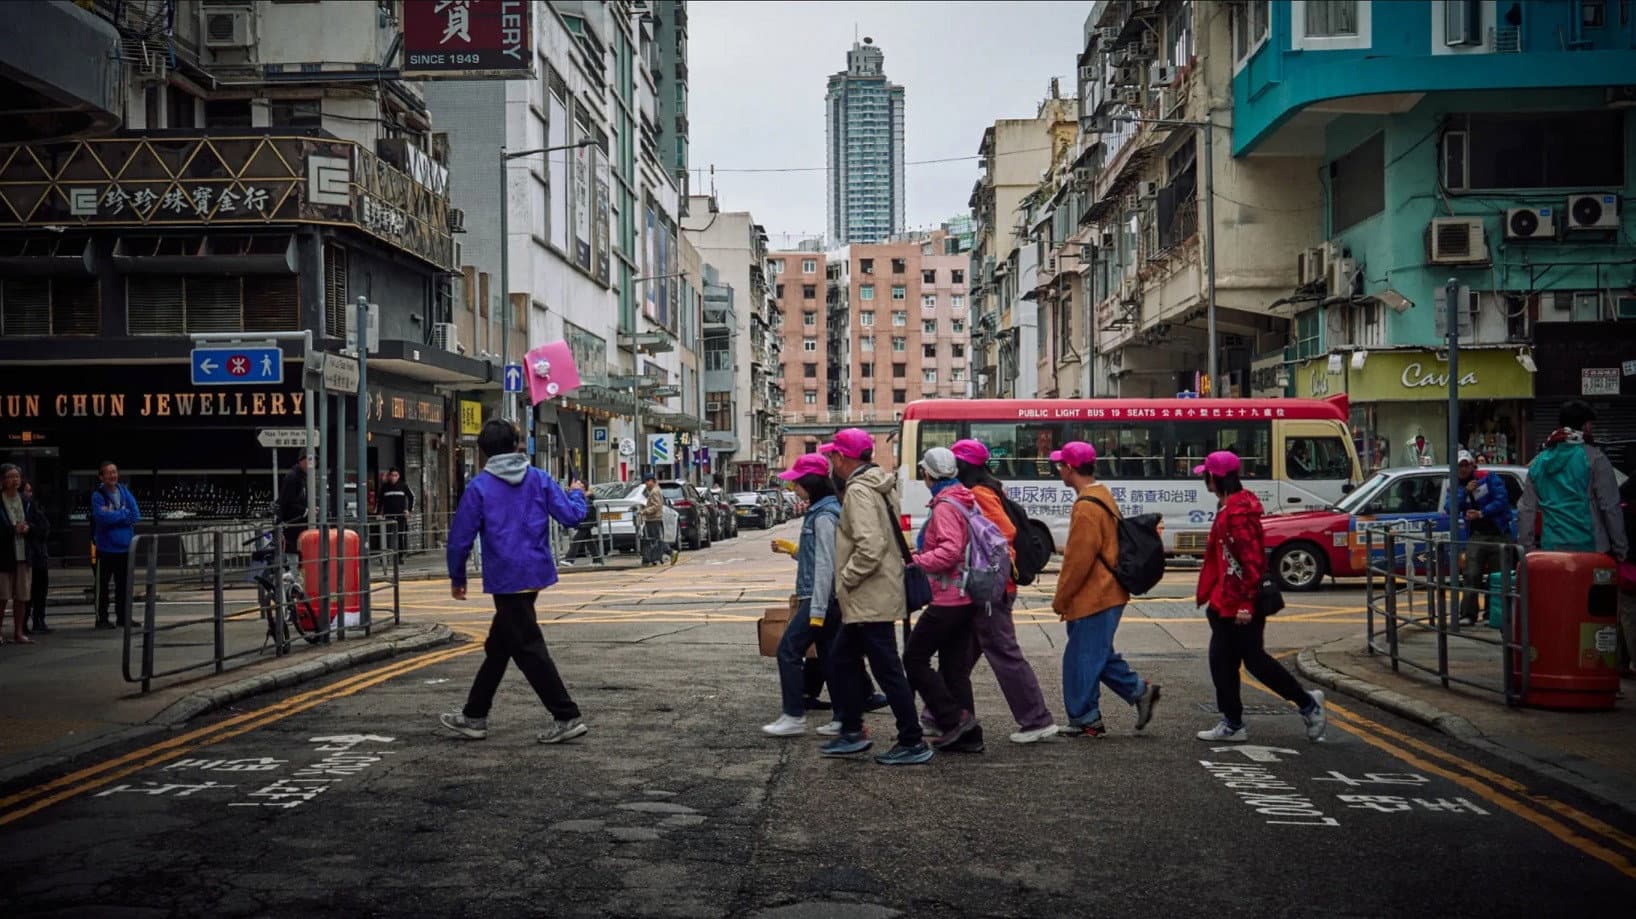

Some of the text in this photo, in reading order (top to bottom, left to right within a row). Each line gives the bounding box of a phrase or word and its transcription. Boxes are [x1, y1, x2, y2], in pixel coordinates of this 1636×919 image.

[409, 54, 481, 64] SINCE 1949
[105, 185, 269, 216] 珍珍珠寶金行
[1401, 363, 1478, 387] Cava
[0, 392, 304, 417] UN CHUN JEWELLERY
[1018, 408, 1048, 417] PUBLIC
[1055, 408, 1080, 417] LIGHT
[1087, 408, 1104, 417] BUS
[1111, 408, 1120, 417] 19
[1127, 408, 1156, 417] SEATS
[1008, 485, 1057, 503] 糖尿病
[1061, 489, 1075, 502] 及
[1131, 489, 1198, 503] 篩查和治理
[228, 751, 396, 809] LOOK LEFT
[1198, 760, 1341, 827] LOOK RIGHT
[1311, 770, 1492, 816] 望右
